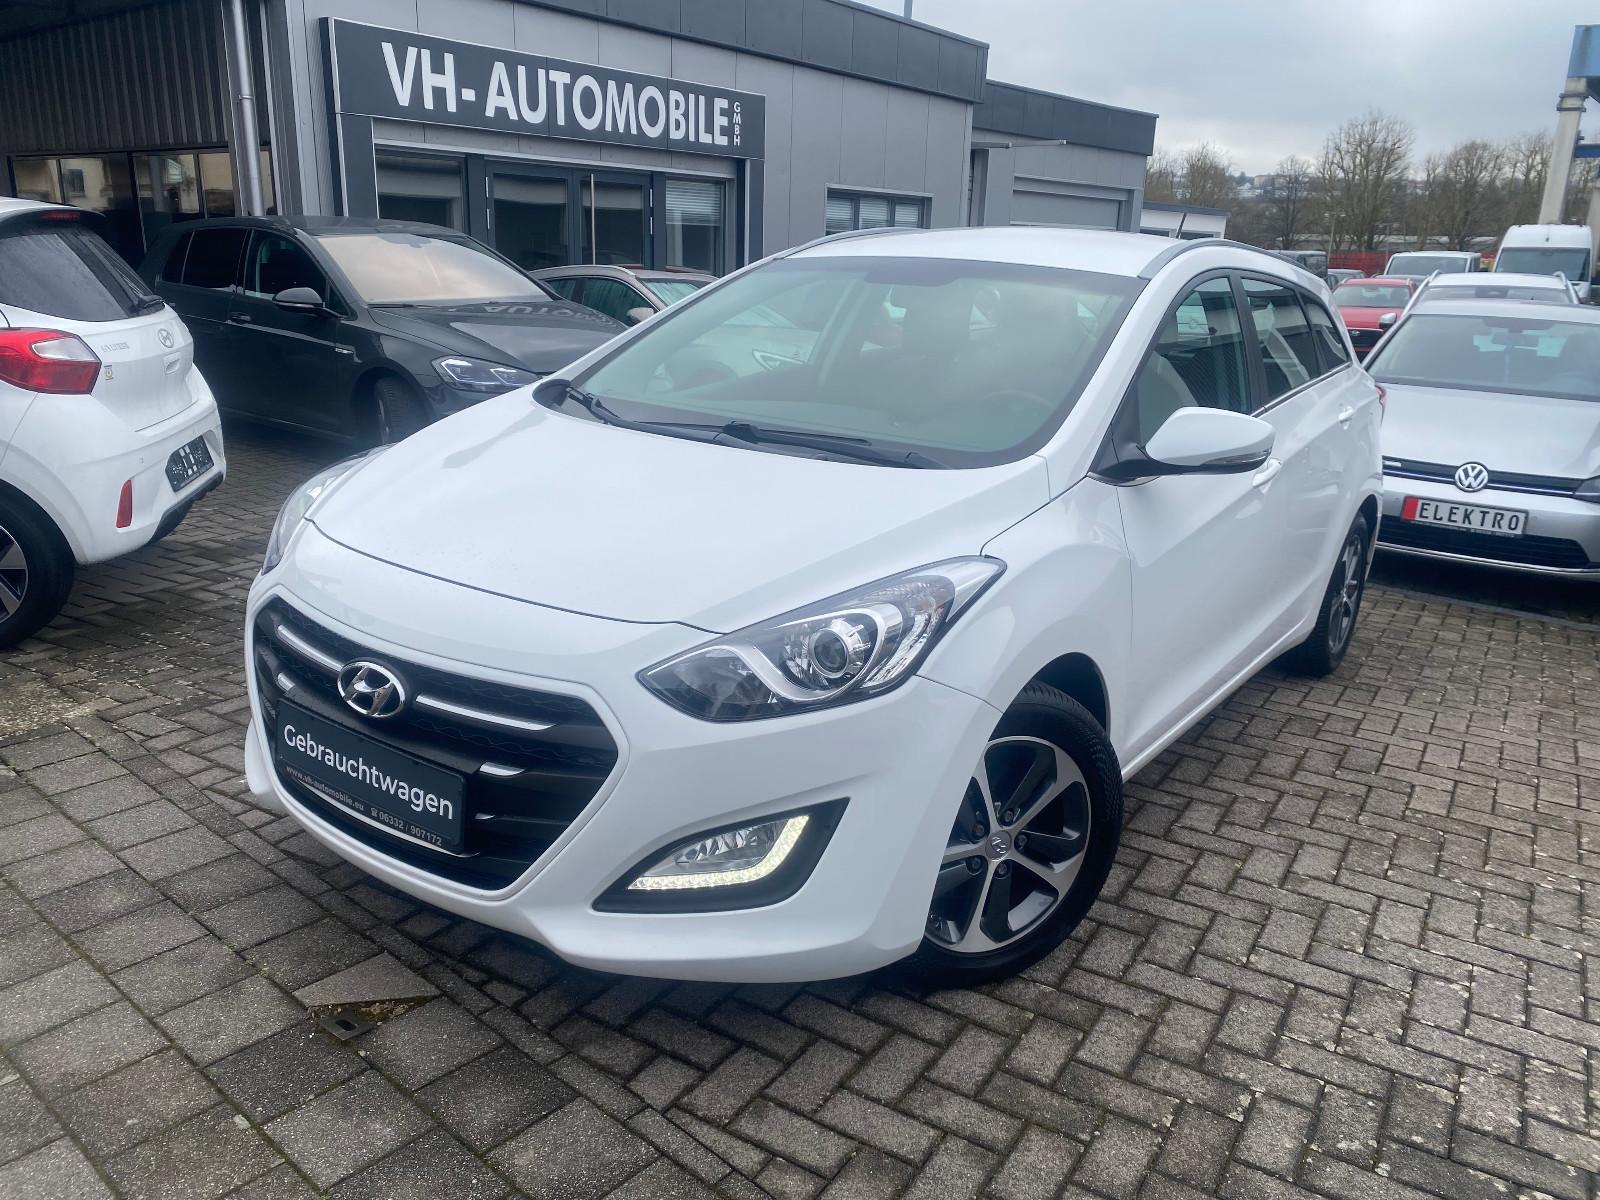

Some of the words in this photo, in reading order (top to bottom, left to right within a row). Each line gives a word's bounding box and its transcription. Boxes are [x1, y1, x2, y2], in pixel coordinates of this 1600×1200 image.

[381, 42, 476, 113] VH-
[485, 61, 728, 146] AUTOMOBILE
[733, 101, 741, 146] GMBH
[1419, 502, 1520, 531] ELEKTRO
[284, 724, 453, 819] Gebrauchtwagen
[379, 811, 404, 830] 06332
[410, 825, 443, 847] 907172
